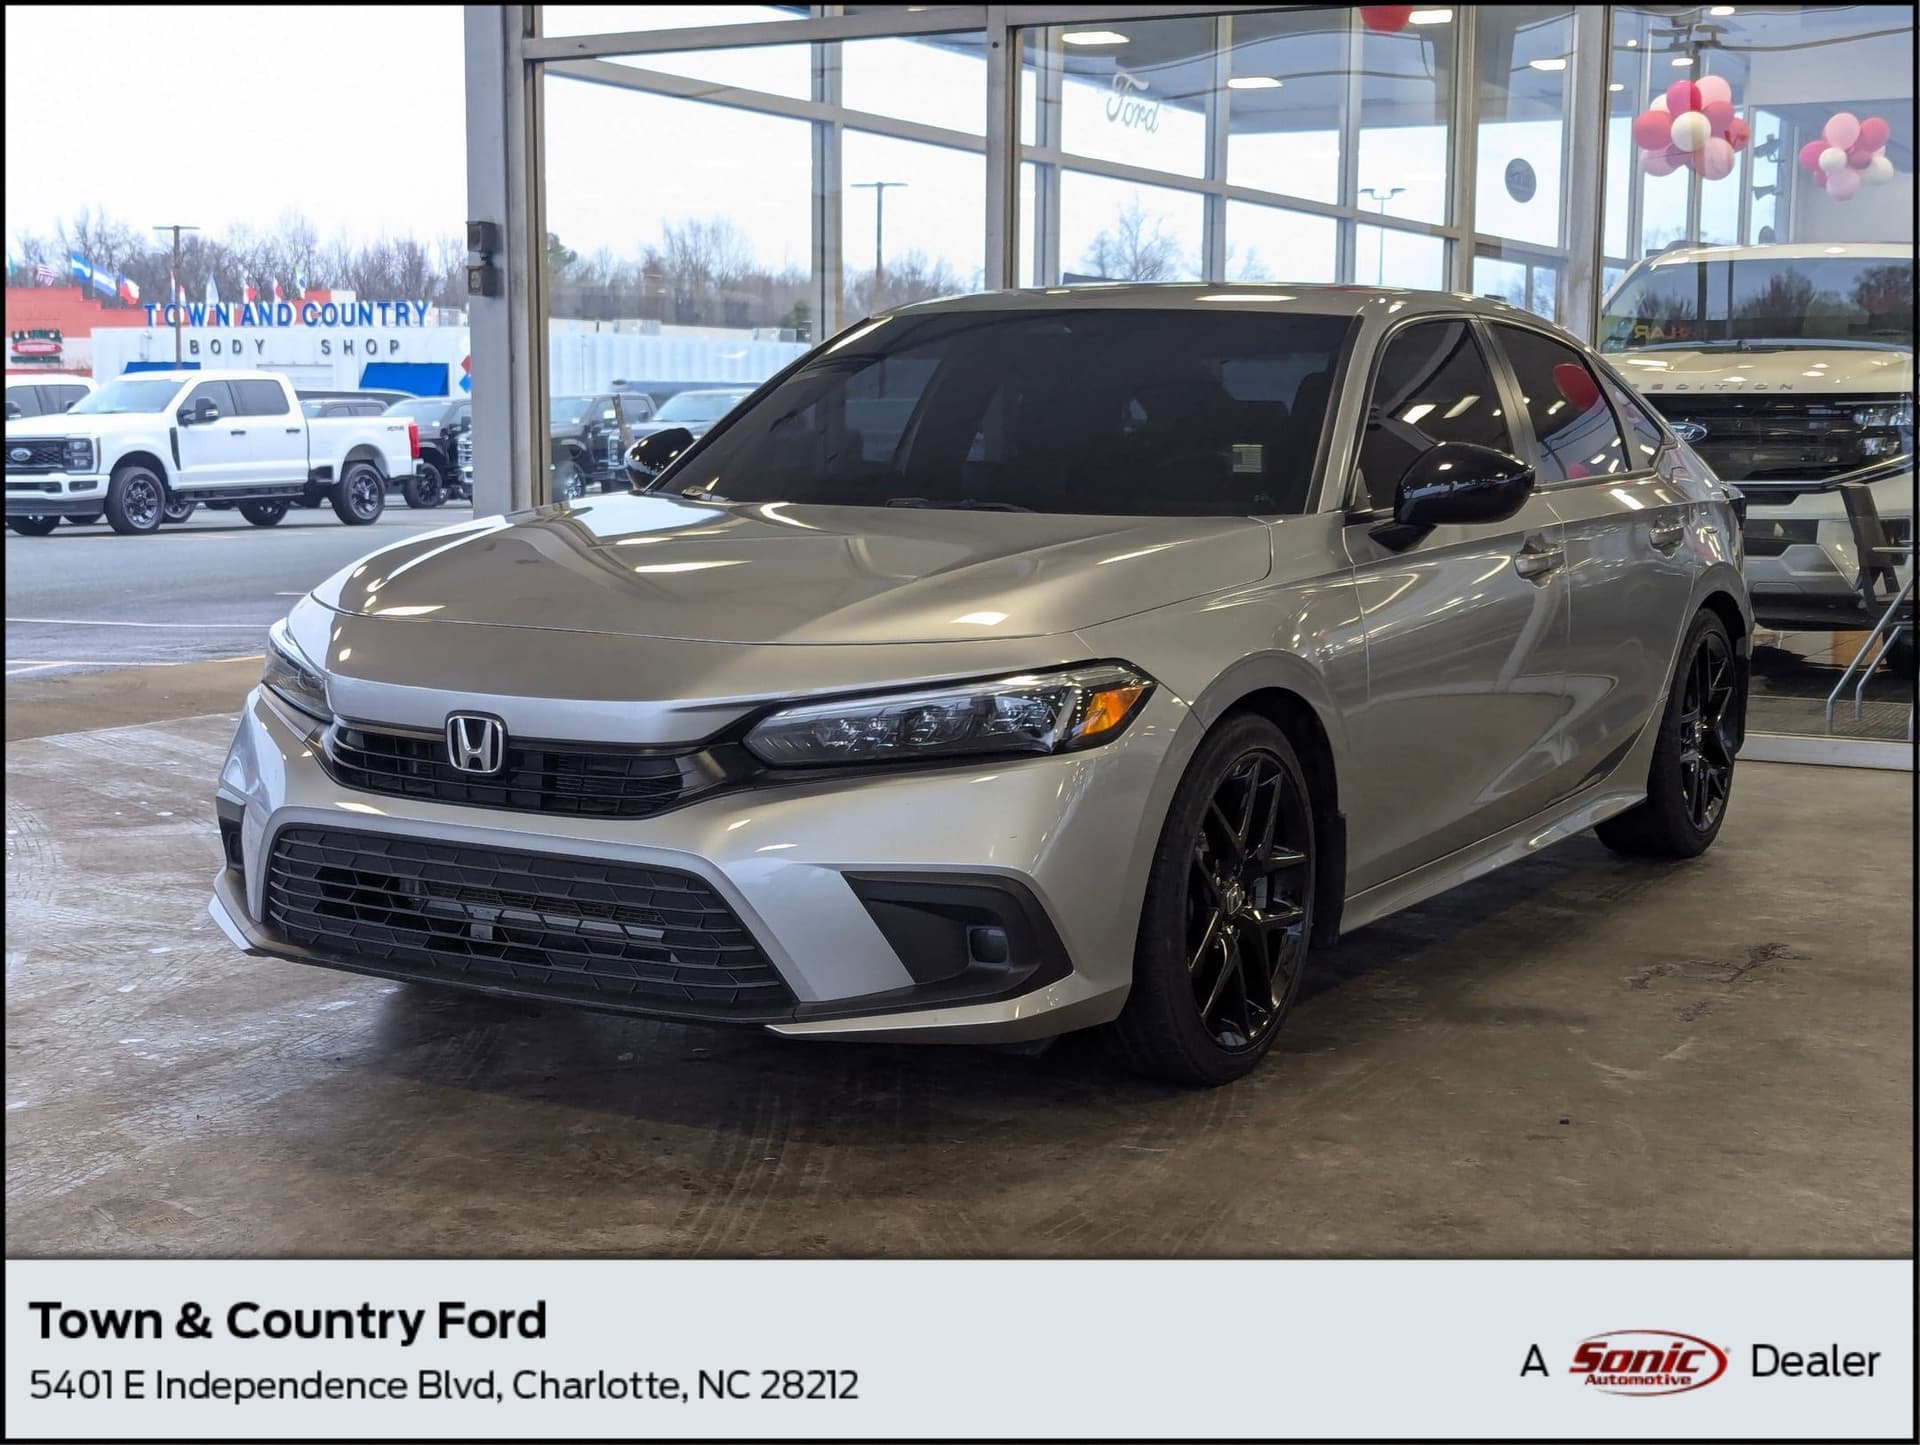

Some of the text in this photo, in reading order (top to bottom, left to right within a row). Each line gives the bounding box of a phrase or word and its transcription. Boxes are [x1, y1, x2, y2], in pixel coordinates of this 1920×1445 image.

[1106, 72, 1160, 134] Ford
[144, 302, 431, 327] TOWN AND COUNTRY
[189, 339, 400, 355] BODY SHOP
